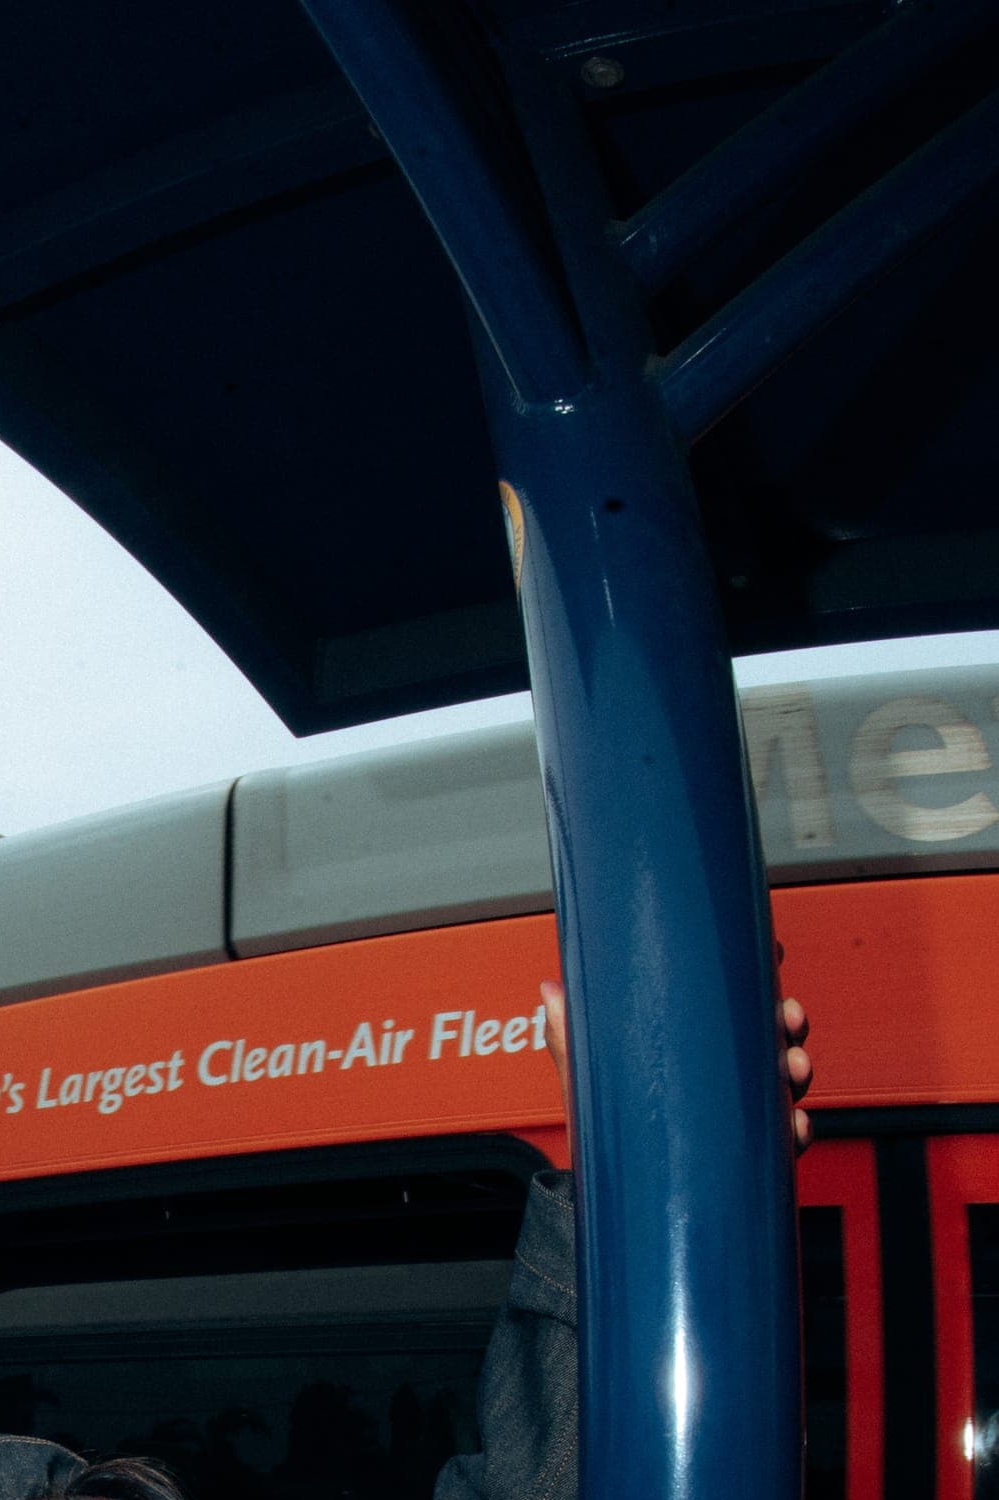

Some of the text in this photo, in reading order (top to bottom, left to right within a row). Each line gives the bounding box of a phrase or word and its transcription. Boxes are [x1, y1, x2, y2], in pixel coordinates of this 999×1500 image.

[37, 1050, 184, 1114] Largest
[198, 1019, 413, 1087] Clean-Air
[429, 1004, 547, 1061] Fleet
